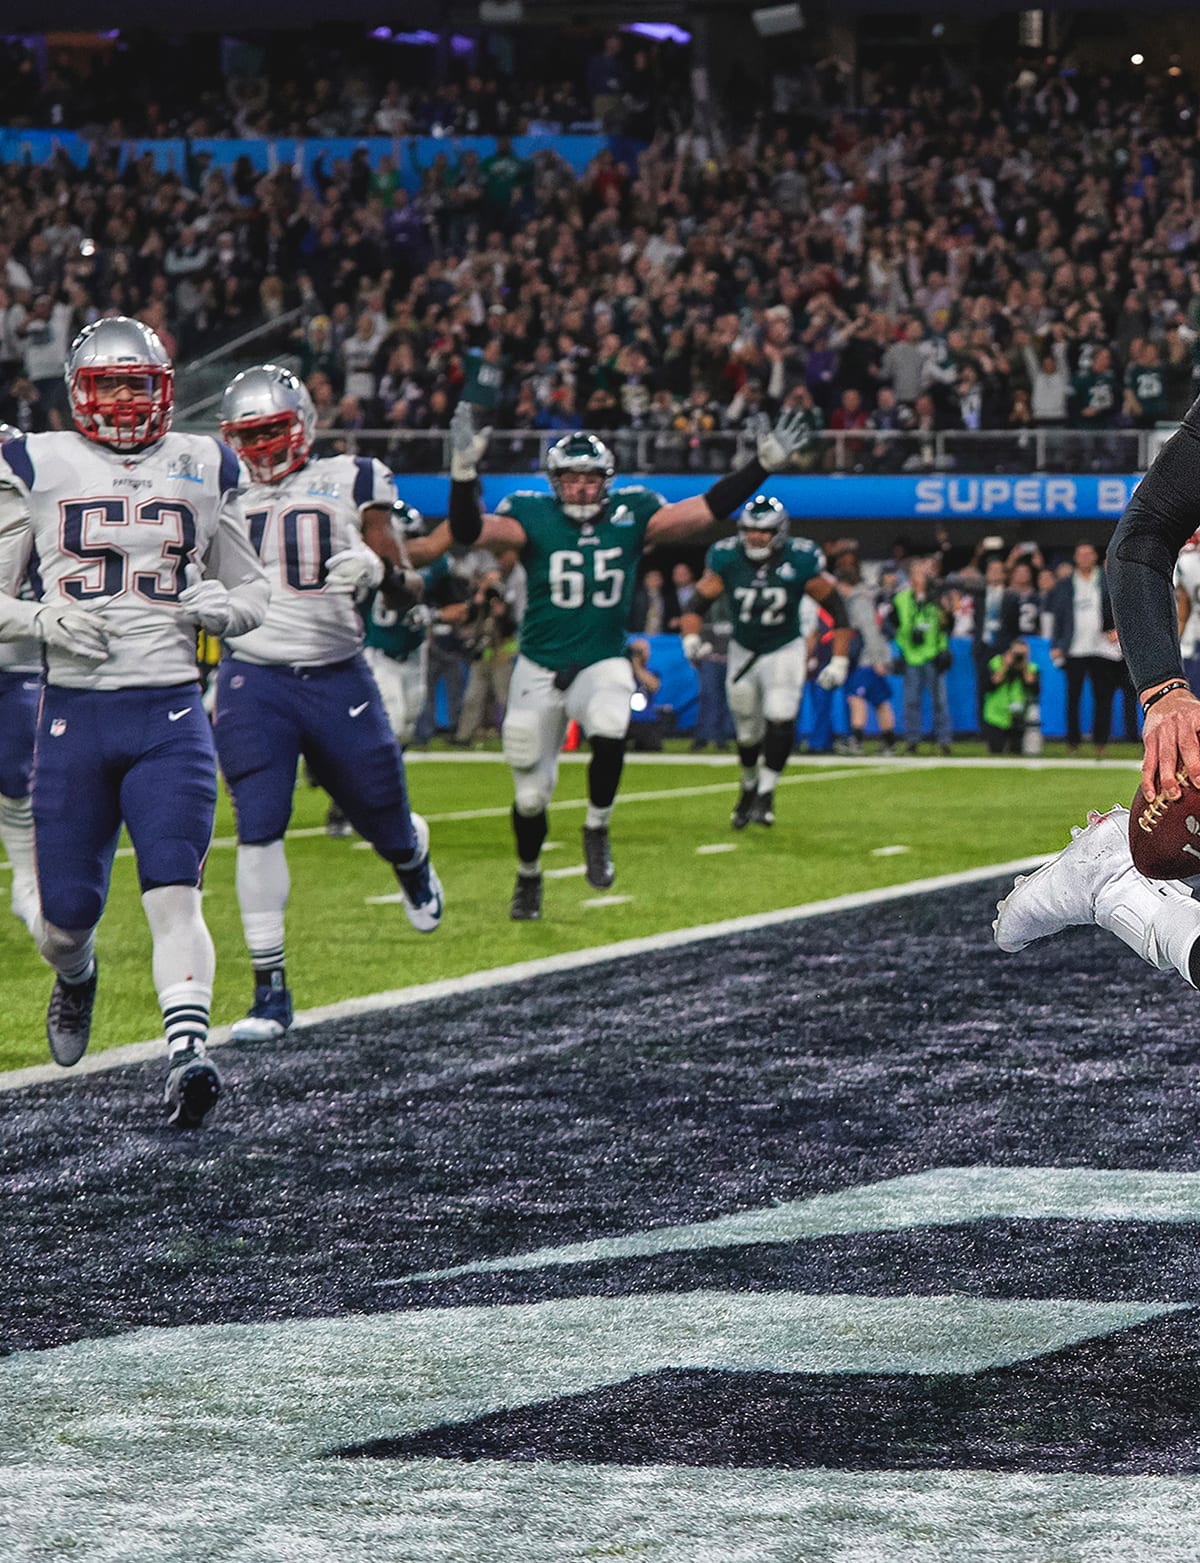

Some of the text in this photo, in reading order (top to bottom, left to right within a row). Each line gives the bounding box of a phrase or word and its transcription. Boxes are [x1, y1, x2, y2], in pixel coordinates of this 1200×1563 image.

[914, 478, 1077, 514] SUPER
[57, 496, 199, 607] 53
[549, 546, 625, 609] 65
[733, 586, 788, 626] 72
